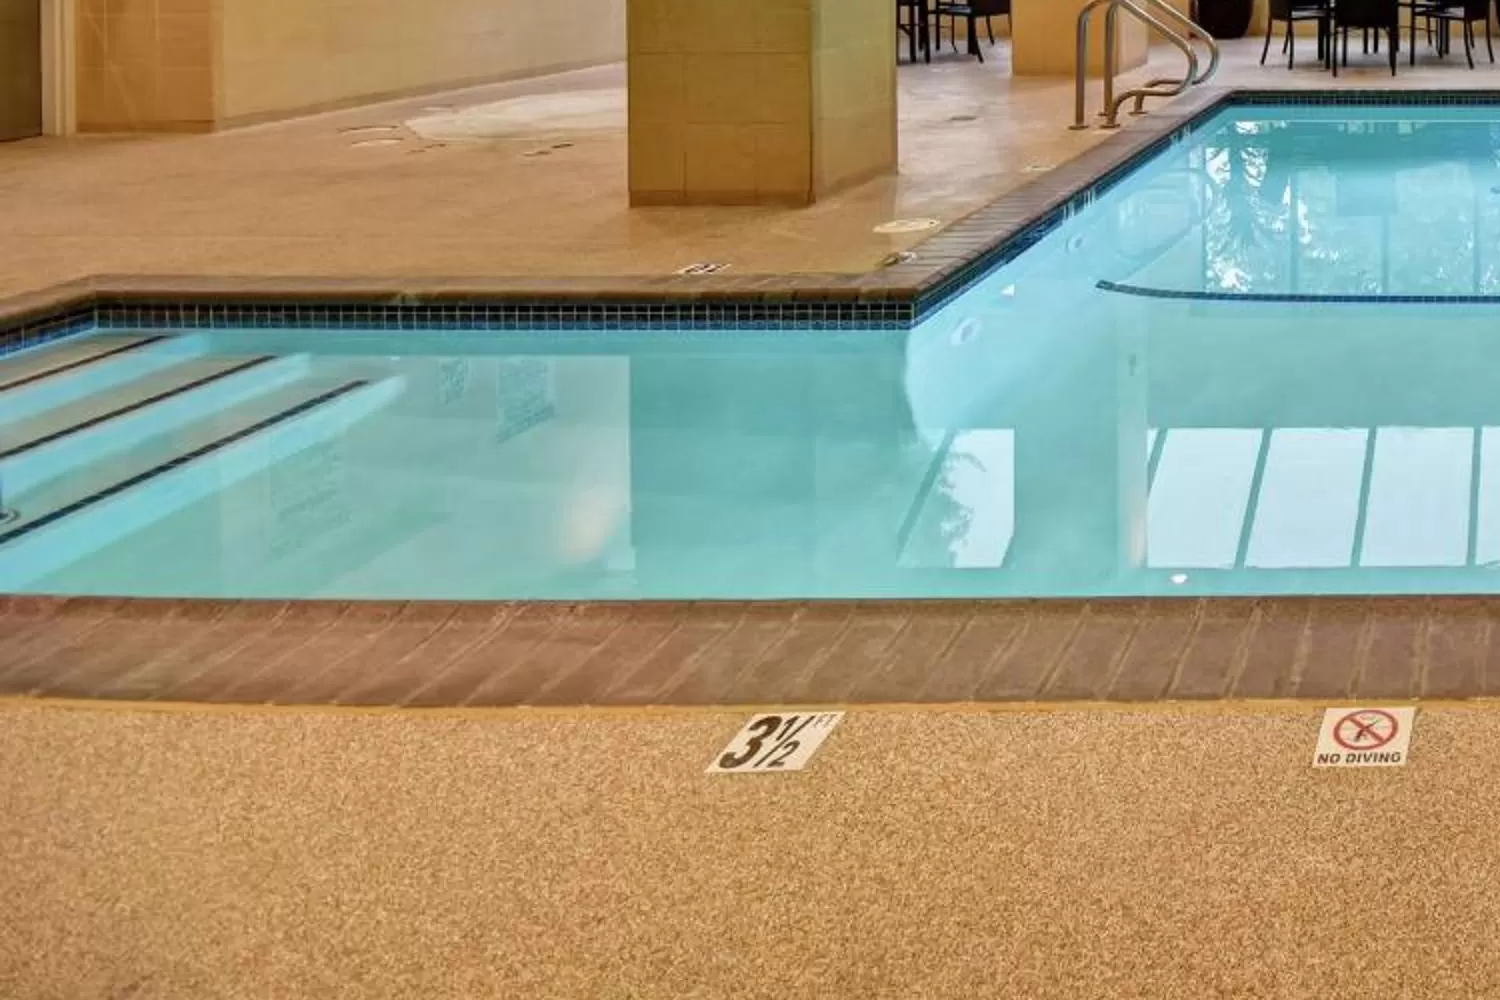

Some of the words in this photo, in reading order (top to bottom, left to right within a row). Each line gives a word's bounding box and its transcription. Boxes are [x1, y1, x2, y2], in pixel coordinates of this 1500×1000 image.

[811, 713, 838, 729] FT
[1317, 753, 1341, 765] NO
[1345, 752, 1402, 764] DIVING
